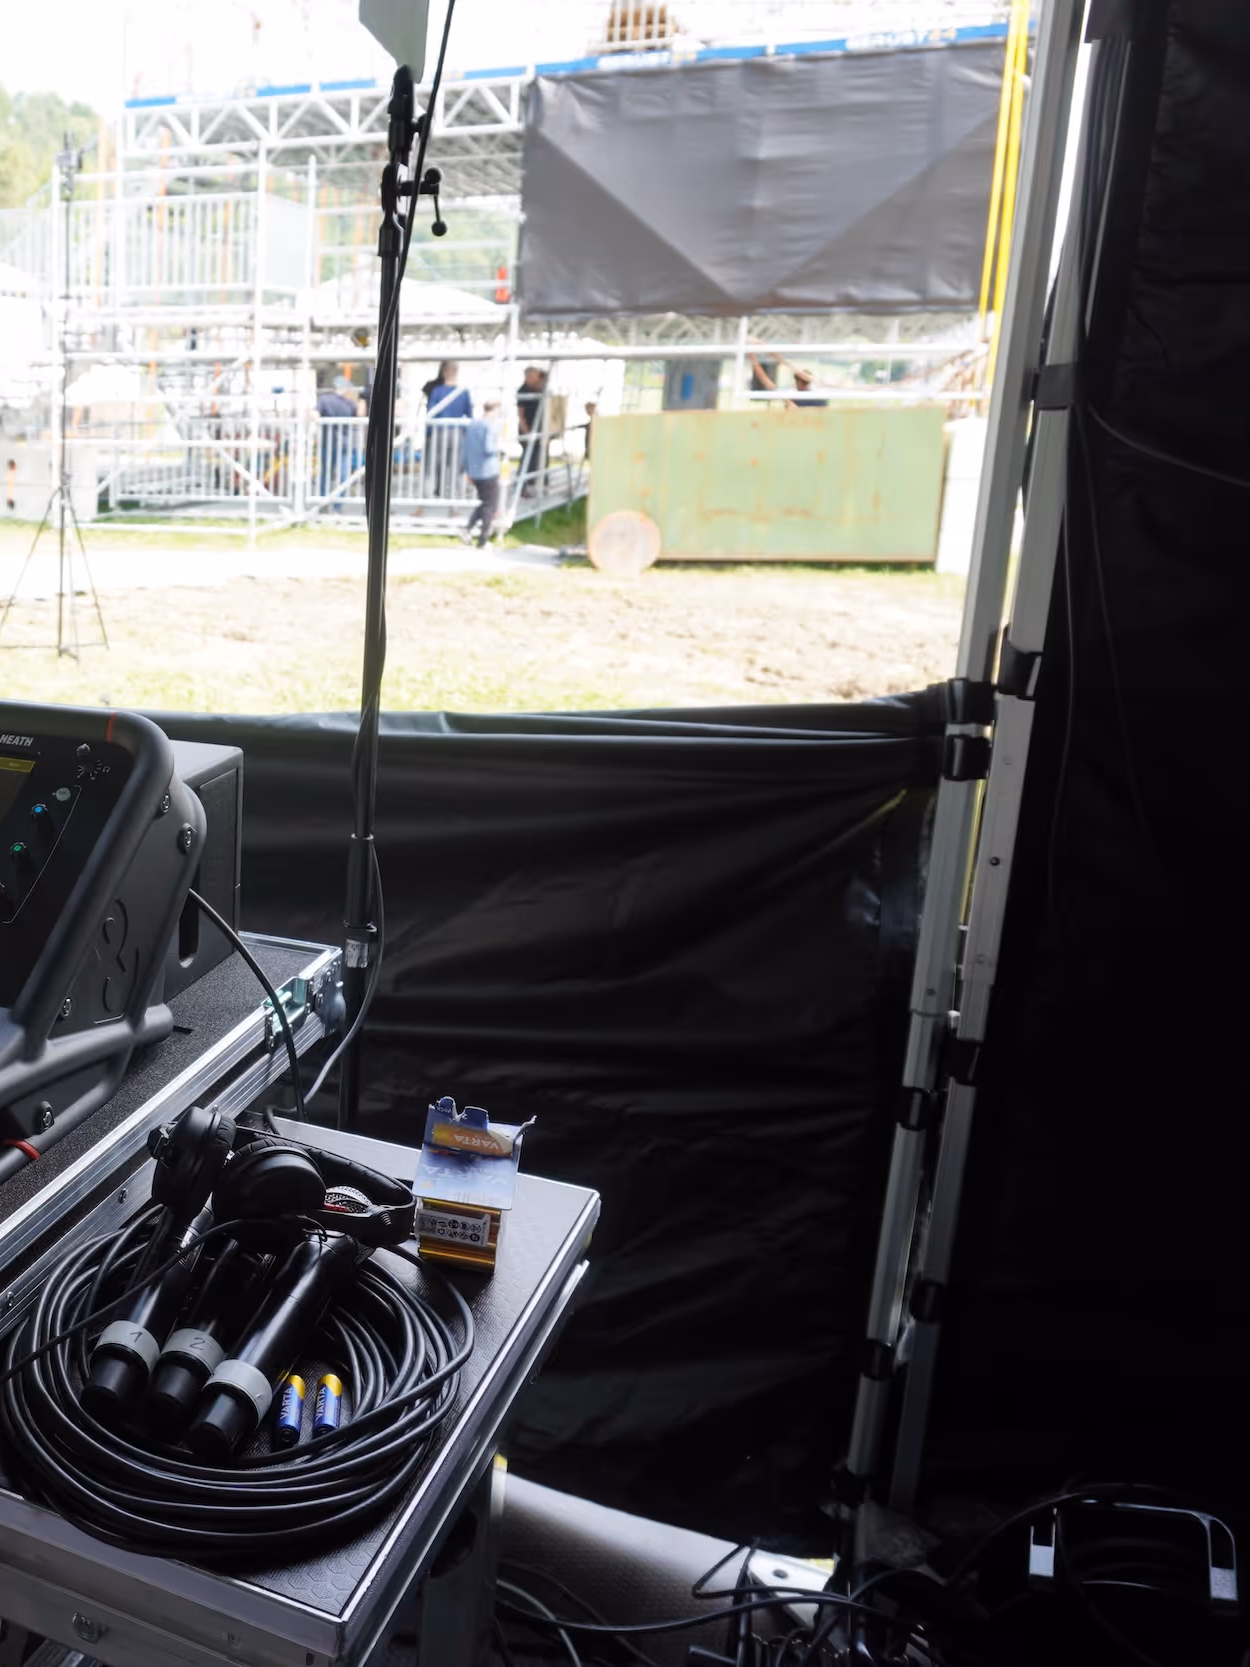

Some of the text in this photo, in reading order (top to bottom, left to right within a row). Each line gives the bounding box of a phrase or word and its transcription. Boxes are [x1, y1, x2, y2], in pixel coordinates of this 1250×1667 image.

[0, 734, 34, 747] HEATH
[454, 1134, 499, 1150] VARTA
[130, 1332, 143, 1343] 1
[189, 1337, 204, 1351] 2
[279, 1386, 294, 1421] VARTA
[315, 1385, 327, 1421] VARTA
